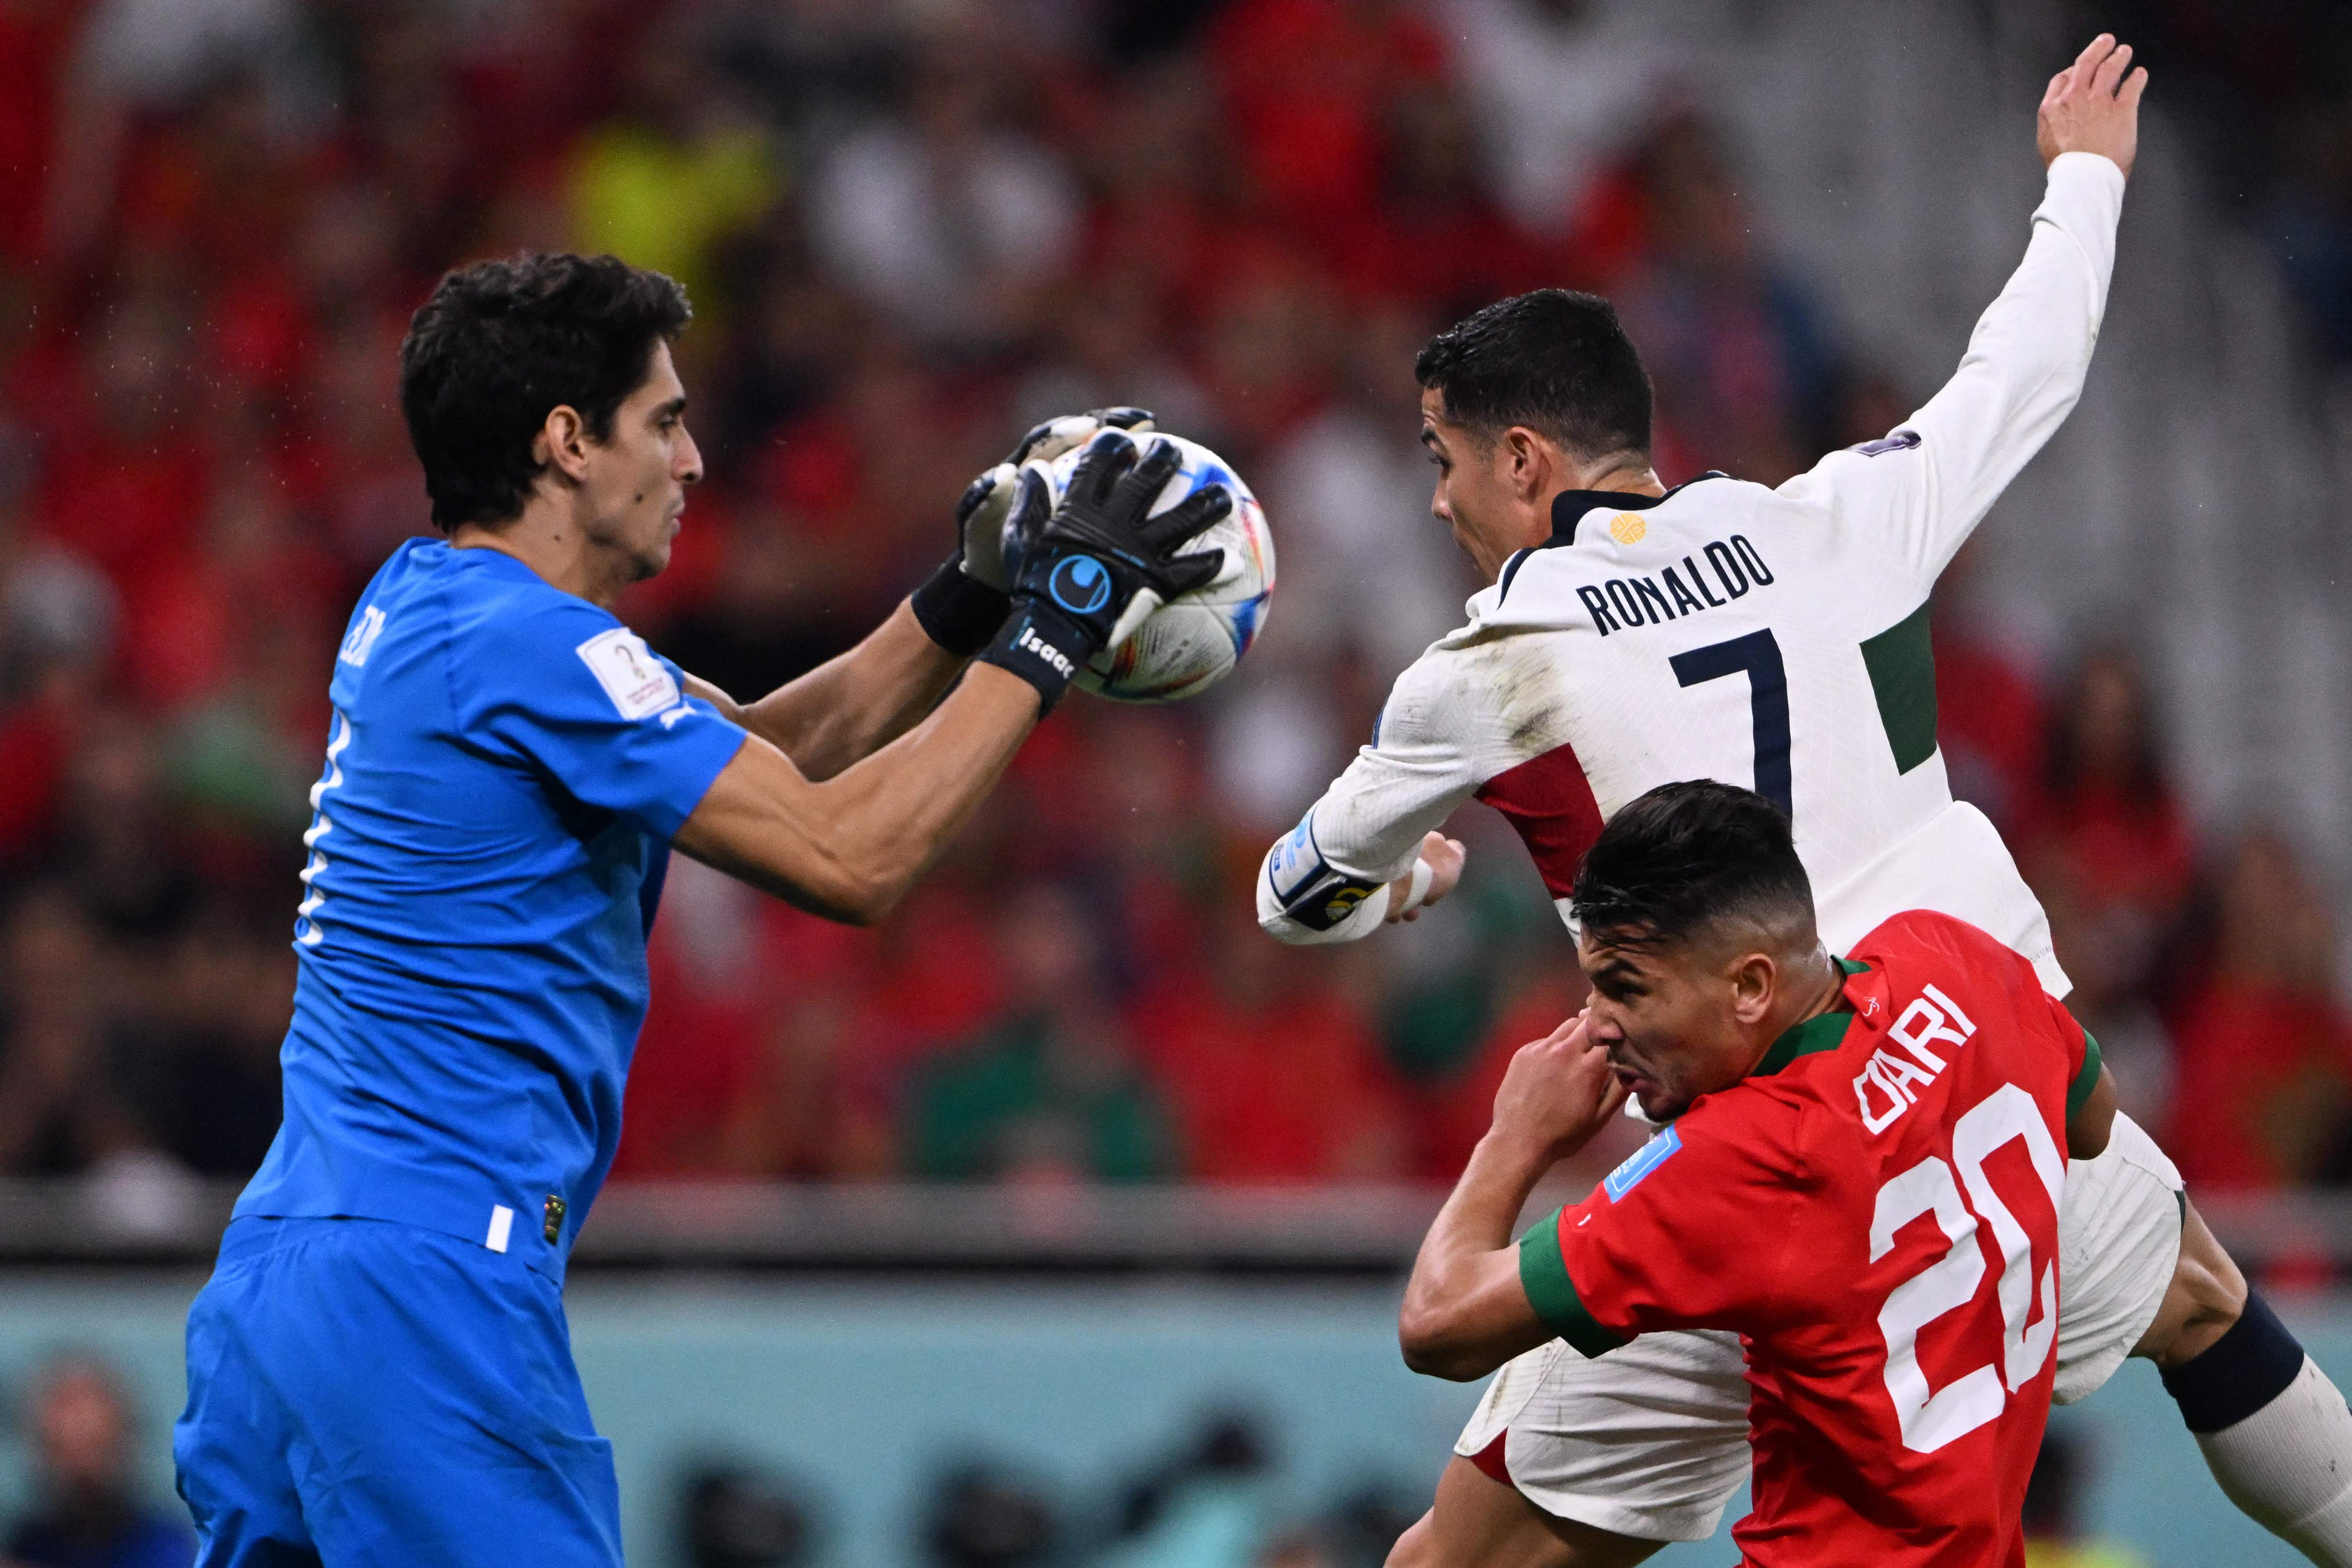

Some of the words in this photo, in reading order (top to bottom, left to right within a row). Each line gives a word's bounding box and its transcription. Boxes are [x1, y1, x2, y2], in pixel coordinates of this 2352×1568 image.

[1576, 534, 1774, 637] RONALDO
[1668, 628, 1792, 824] 7
[1853, 983, 1978, 1135] DARI
[1869, 1082, 2066, 1454] 20
